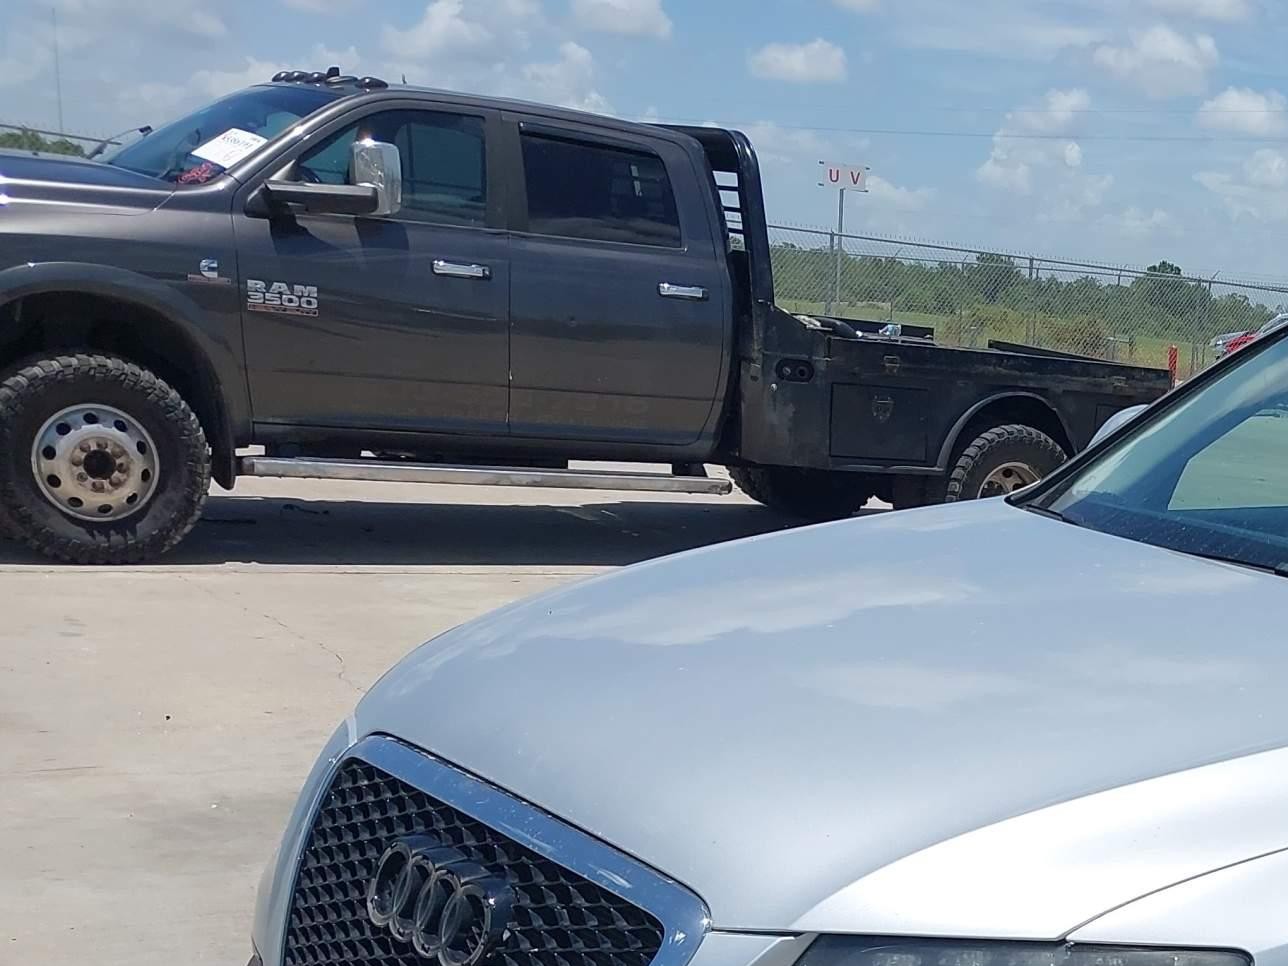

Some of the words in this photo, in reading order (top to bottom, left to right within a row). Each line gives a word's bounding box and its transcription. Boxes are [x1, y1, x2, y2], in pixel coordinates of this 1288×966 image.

[829, 168, 840, 183] U
[850, 170, 861, 185] V
[246, 279, 318, 297] RAM
[247, 291, 318, 309] 3500
